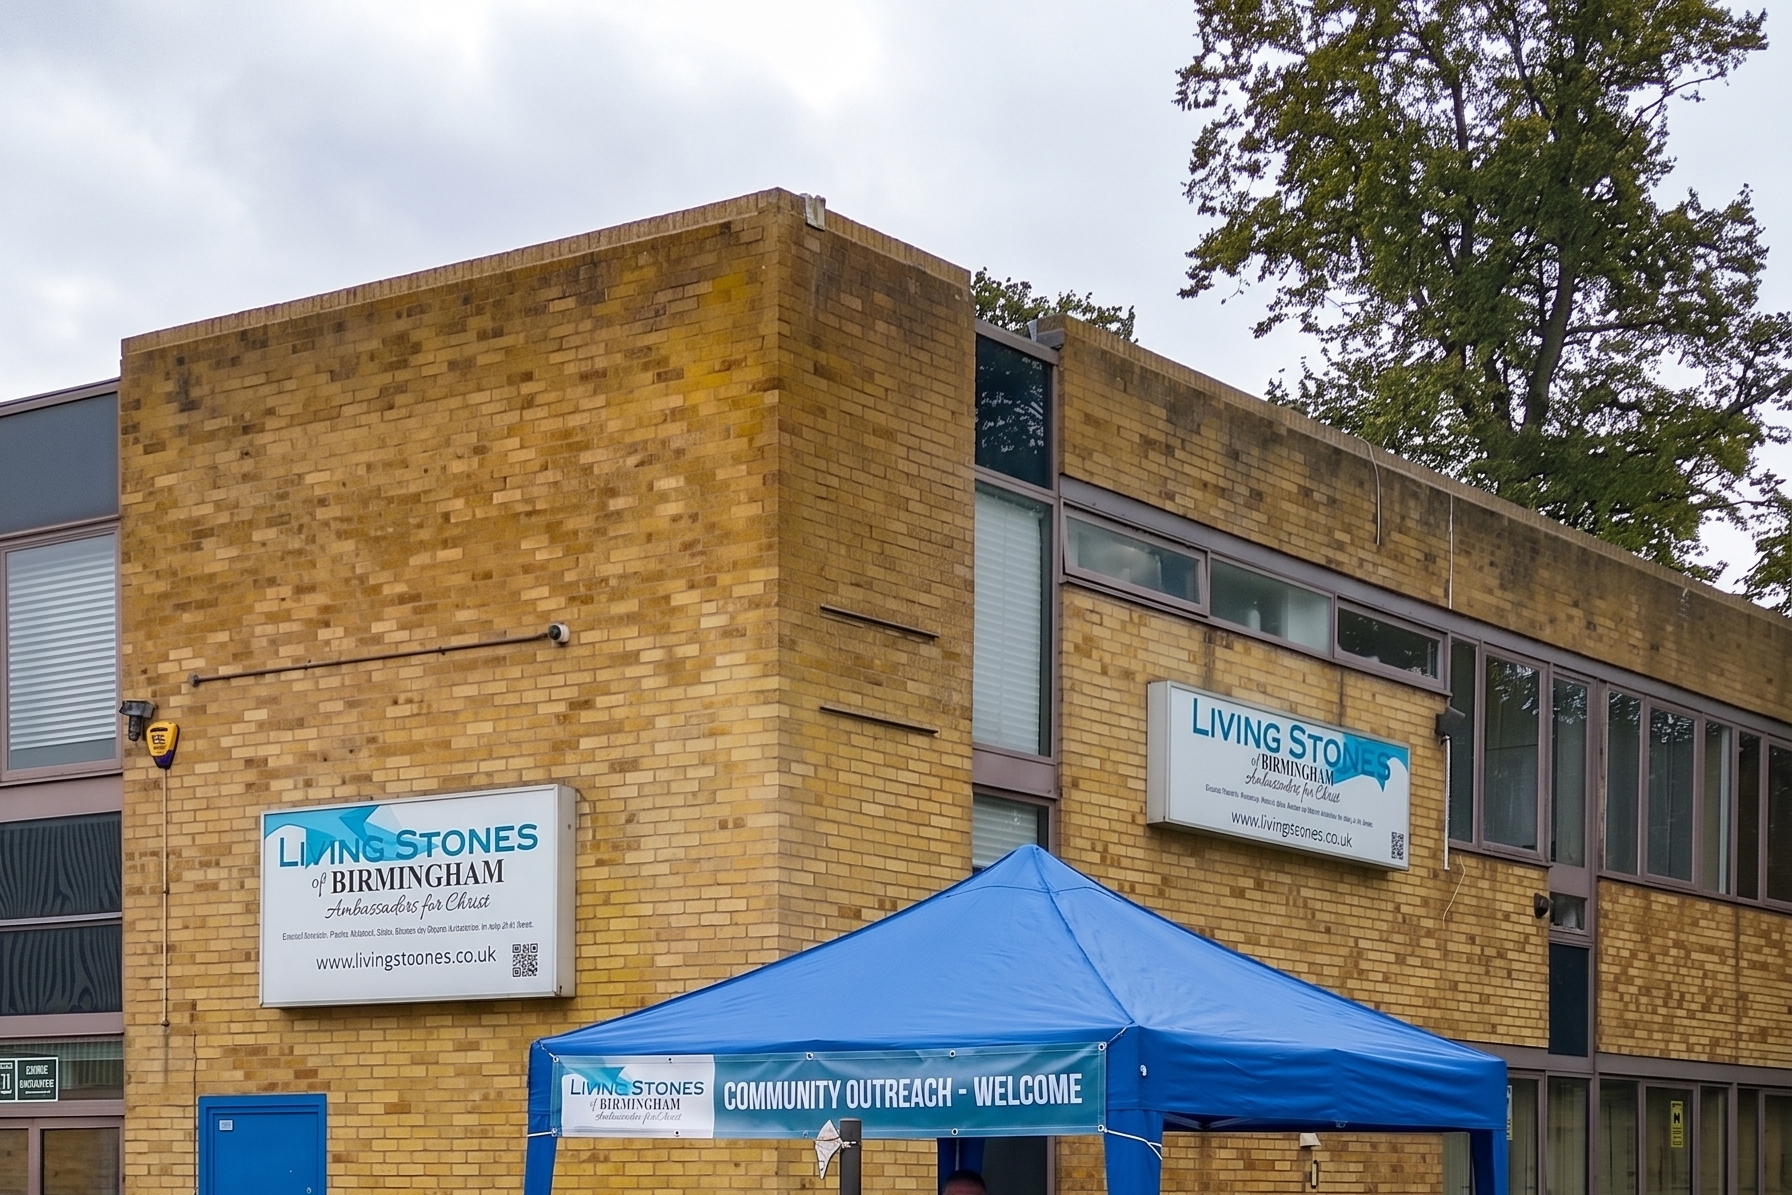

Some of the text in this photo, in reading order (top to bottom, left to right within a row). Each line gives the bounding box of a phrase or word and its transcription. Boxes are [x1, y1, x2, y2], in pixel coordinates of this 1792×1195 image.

[1192, 697, 1392, 781] LIVING STONES
[1261, 753, 1335, 787] BIRMINGHAM
[279, 823, 539, 868] LIVING STONES
[311, 858, 505, 897] of BIRMINGHAM
[325, 891, 491, 921] Ambassadors for Christ
[600, 1097, 680, 1110] BIRMINGHAM
[631, 1080, 705, 1096] STONES
[723, 1079, 842, 1112] COMMUNITY
[846, 1076, 953, 1109] OUTREACH
[973, 1073, 1083, 1107] WELCOME
